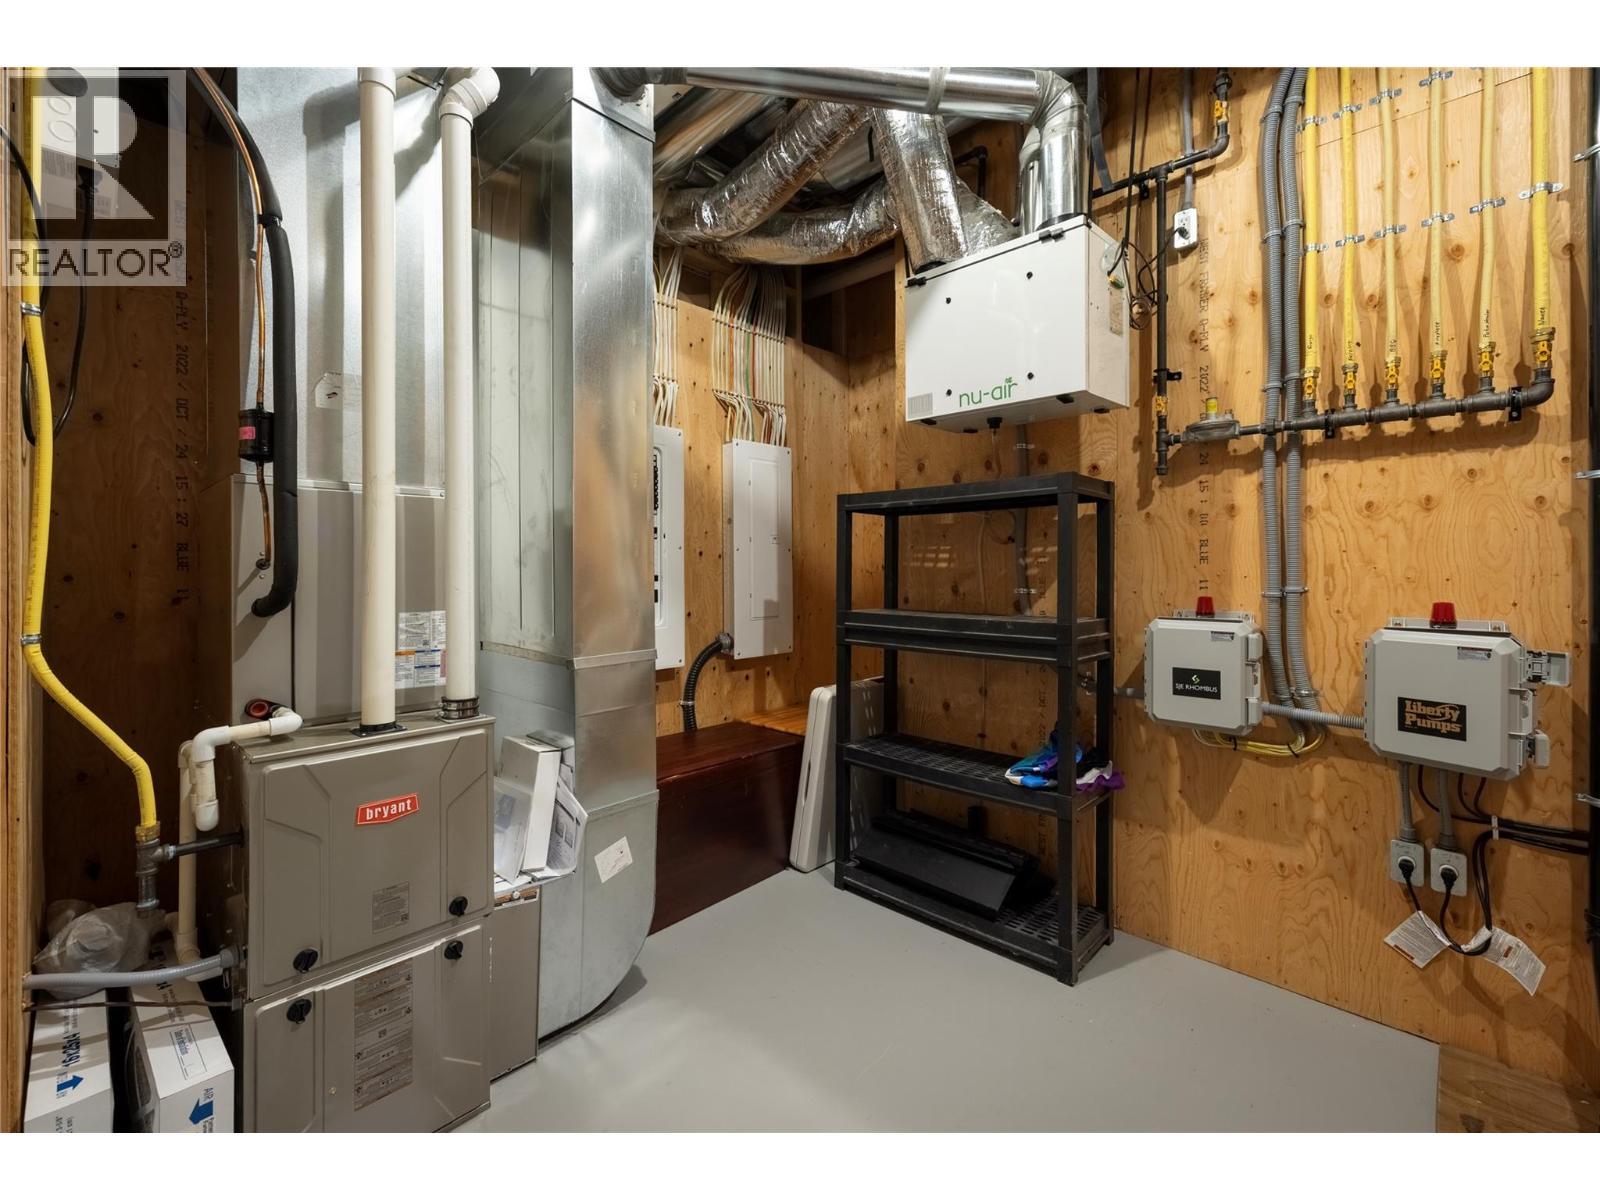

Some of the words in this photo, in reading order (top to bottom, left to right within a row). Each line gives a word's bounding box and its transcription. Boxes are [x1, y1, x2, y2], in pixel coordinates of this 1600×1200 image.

[176, 344, 189, 375] 2022
[1199, 365, 1209, 393] 2022
[959, 377, 1018, 408] nu-air
[176, 398, 189, 421] OCT
[176, 444, 189, 459] 24
[176, 512, 189, 528] 27
[176, 543, 189, 573] BLUE
[1199, 538, 1209, 565] BLUE
[1185, 684, 1218, 693] RHOMBUS
[1405, 700, 1460, 722] Liberty
[1404, 713, 1463, 734] Pumps
[365, 799, 413, 821] bryant
[61, 1031, 81, 1068] 16x25x4
